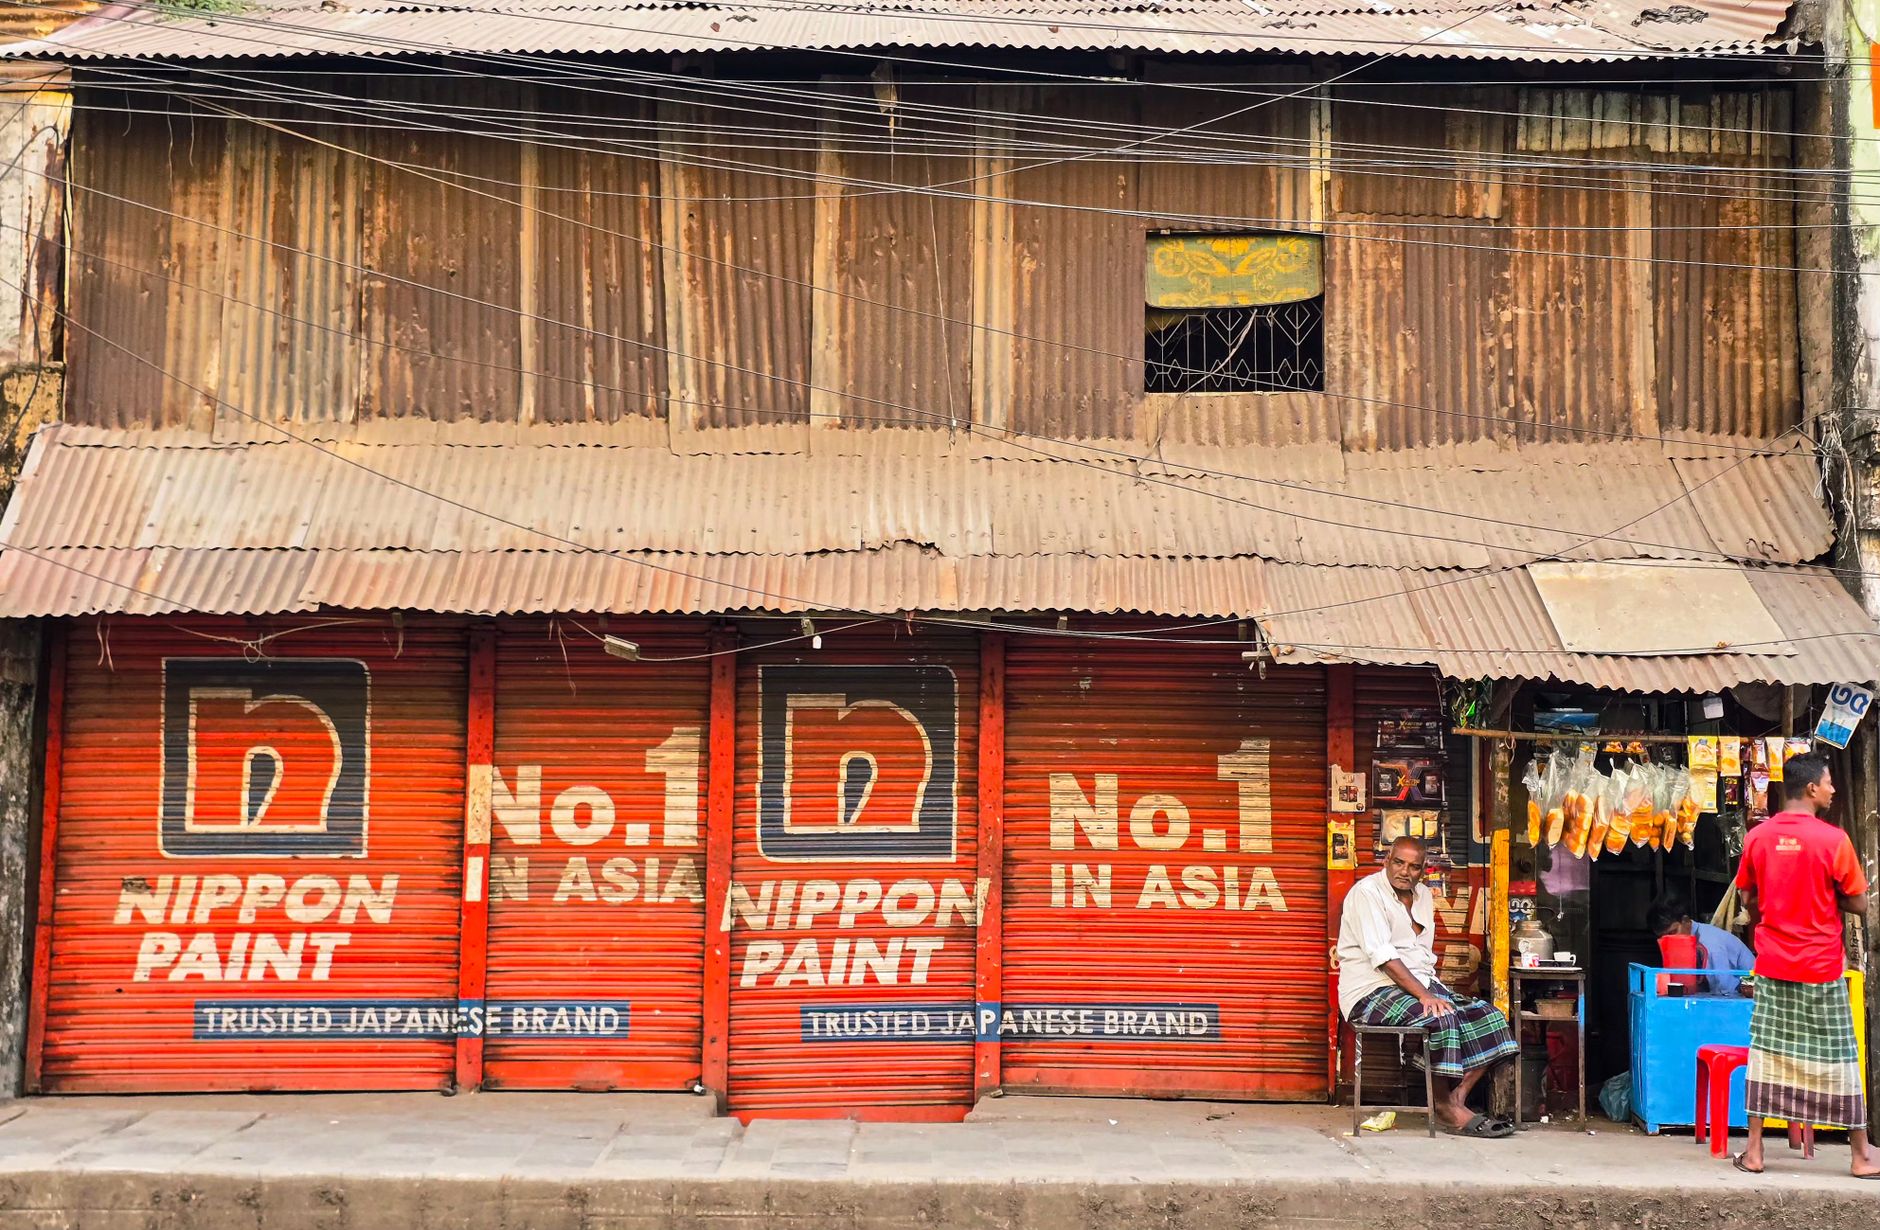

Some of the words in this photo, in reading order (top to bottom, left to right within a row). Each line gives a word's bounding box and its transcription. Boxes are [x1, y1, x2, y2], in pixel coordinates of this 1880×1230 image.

[468, 726, 701, 846] No.1
[1048, 737, 1273, 854] No.1
[112, 873, 400, 926] NIPPON
[464, 855, 529, 902] IN
[551, 856, 706, 903] ASIA
[719, 876, 992, 932] NIPPON
[1050, 863, 1113, 909] IN
[1135, 863, 1289, 913] ASIA
[132, 932, 352, 983] PAINT
[738, 936, 945, 988] PAINT
[202, 1006, 334, 1035] TRUSTED
[340, 1006, 502, 1036] JAPANESE
[511, 1006, 621, 1037] BRAND
[808, 1010, 931, 1038] TRUSTED
[939, 1008, 1094, 1038] JAPANESE
[1104, 1009, 1209, 1037] BRAND
